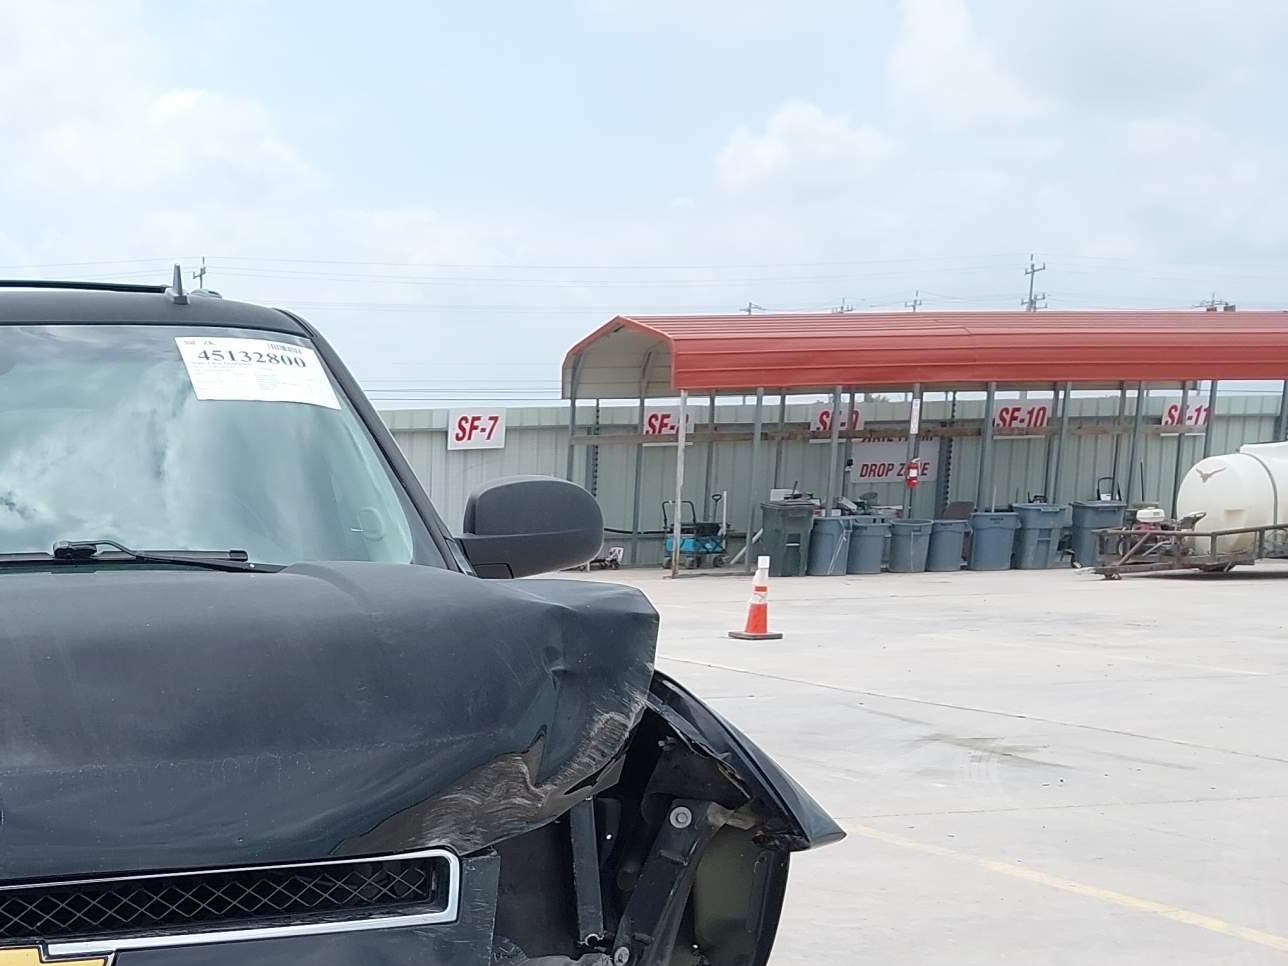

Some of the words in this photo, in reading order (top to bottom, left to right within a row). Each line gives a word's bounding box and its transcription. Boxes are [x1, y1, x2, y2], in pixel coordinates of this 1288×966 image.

[197, 349, 307, 368] 45132800
[645, 413, 690, 435] SF-
[997, 406, 1048, 428] SF-10
[455, 415, 500, 442] SF-7
[859, 463, 894, 478] DROP
[896, 462, 930, 477] ZE
